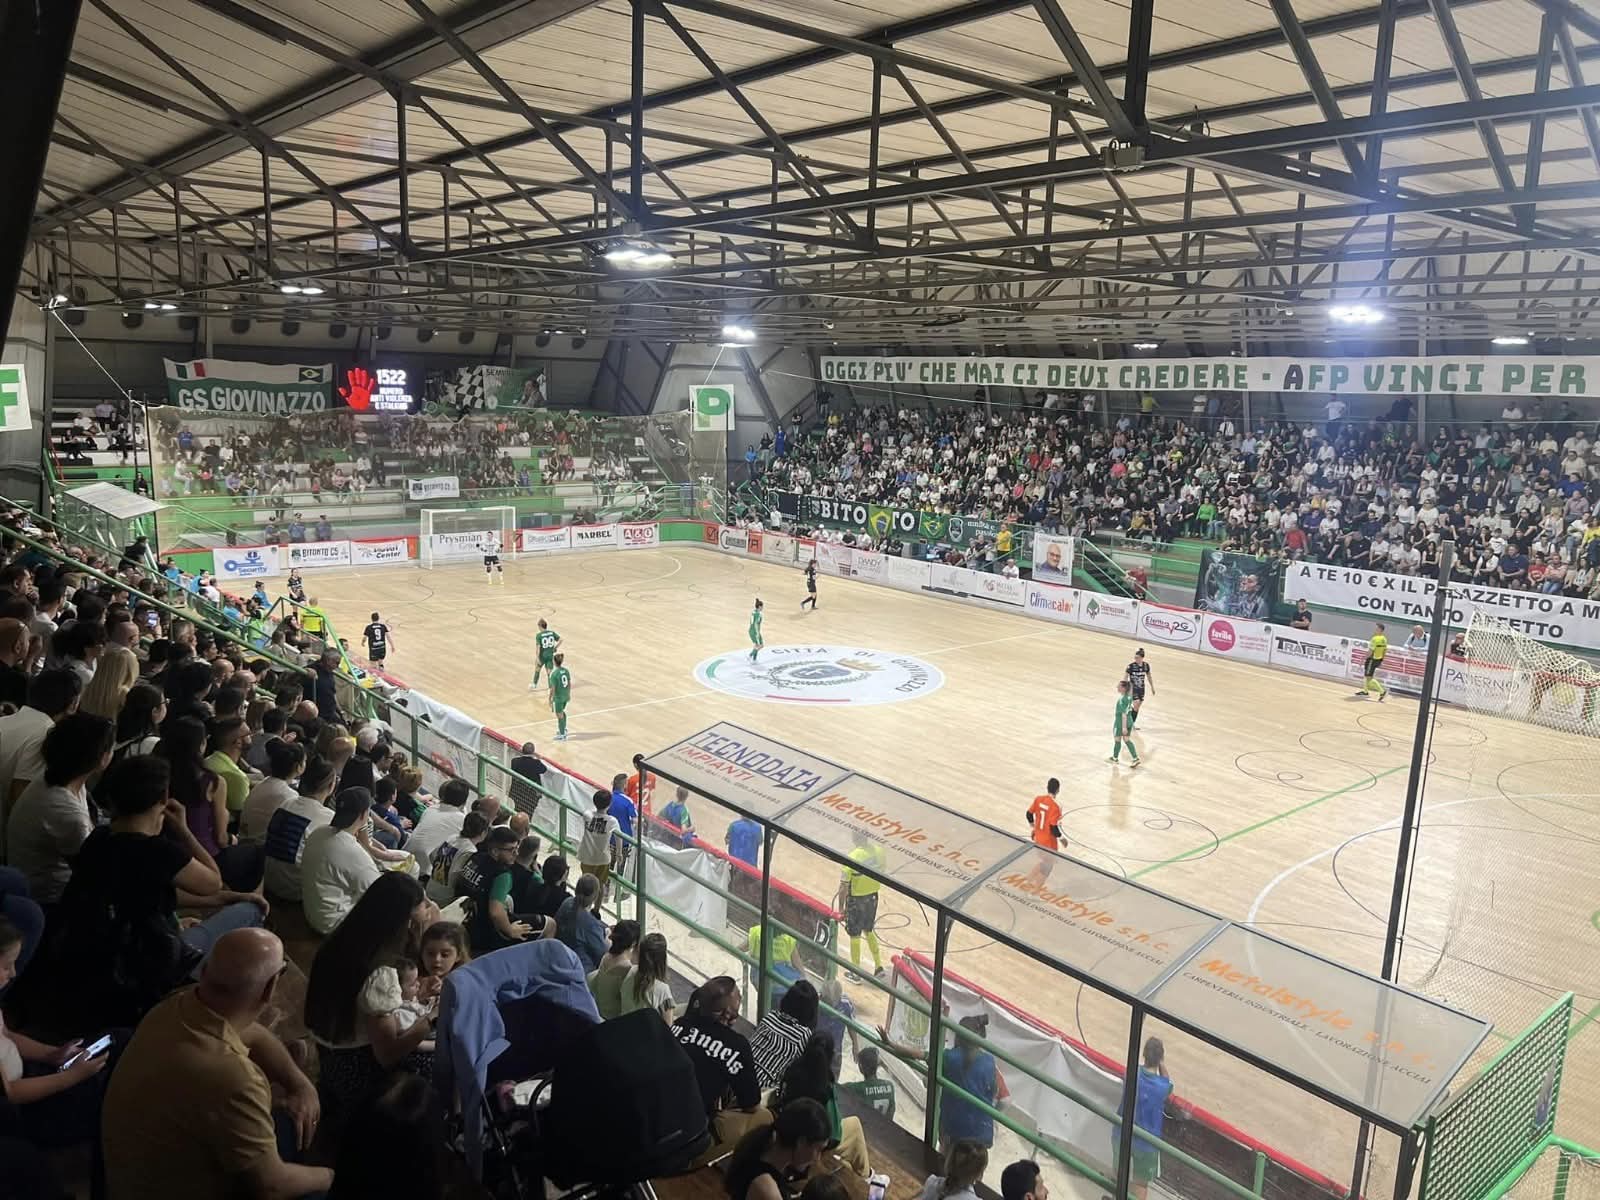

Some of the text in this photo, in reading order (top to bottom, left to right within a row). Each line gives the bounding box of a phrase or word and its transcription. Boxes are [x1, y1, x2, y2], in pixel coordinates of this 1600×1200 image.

[376, 368, 407, 385] 1522
[825, 360, 868, 380] OGGI
[873, 361, 913, 382] PIU'
[919, 362, 957, 383] CHE
[964, 362, 1005, 384] MAI
[1012, 363, 1039, 386] CI
[1047, 364, 1109, 388] DEVI
[1119, 364, 1249, 389] CREDERE
[1283, 363, 1349, 391] AFP
[1363, 363, 1485, 392] VINCI
[1502, 364, 1586, 394] PER
[178, 386, 326, 415] GS GIOVINAZZO
[696, 388, 731, 428] P
[820, 499, 915, 532] BITOTO
[439, 534, 482, 545] Prysmian
[577, 530, 612, 540] MARBEL
[375, 551, 401, 559] Center
[1300, 566, 1311, 578] A
[1316, 567, 1337, 581] TE
[1343, 571, 1362, 585] 10
[1367, 575, 1378, 588] €
[1383, 577, 1395, 590] X
[1401, 579, 1417, 593] IL
[1424, 583, 1553, 612] PLAZZETTO
[1560, 602, 1574, 616] A
[374, 628, 381, 640] 9
[1357, 595, 1395, 612] CON
[1472, 611, 1564, 638] FETTO
[677, 745, 754, 781] IMPIANTI
[694, 731, 822, 792] TECNODATA
[818, 793, 981, 872] Metalstyle s.n.c.
[1001, 873, 1170, 955] Metalstyle s.n.c.
[1182, 971, 1242, 1002] CARPENTERIA
[1241, 998, 1310, 1031] INDUSTRIALE
[1315, 1030, 1390, 1065] LAVORAZIONE
[1389, 1061, 1433, 1085] ACCIAI
[1200, 959, 1438, 1070] Metalstyle s.n.c.
[680, 1027, 744, 1075] Angels
